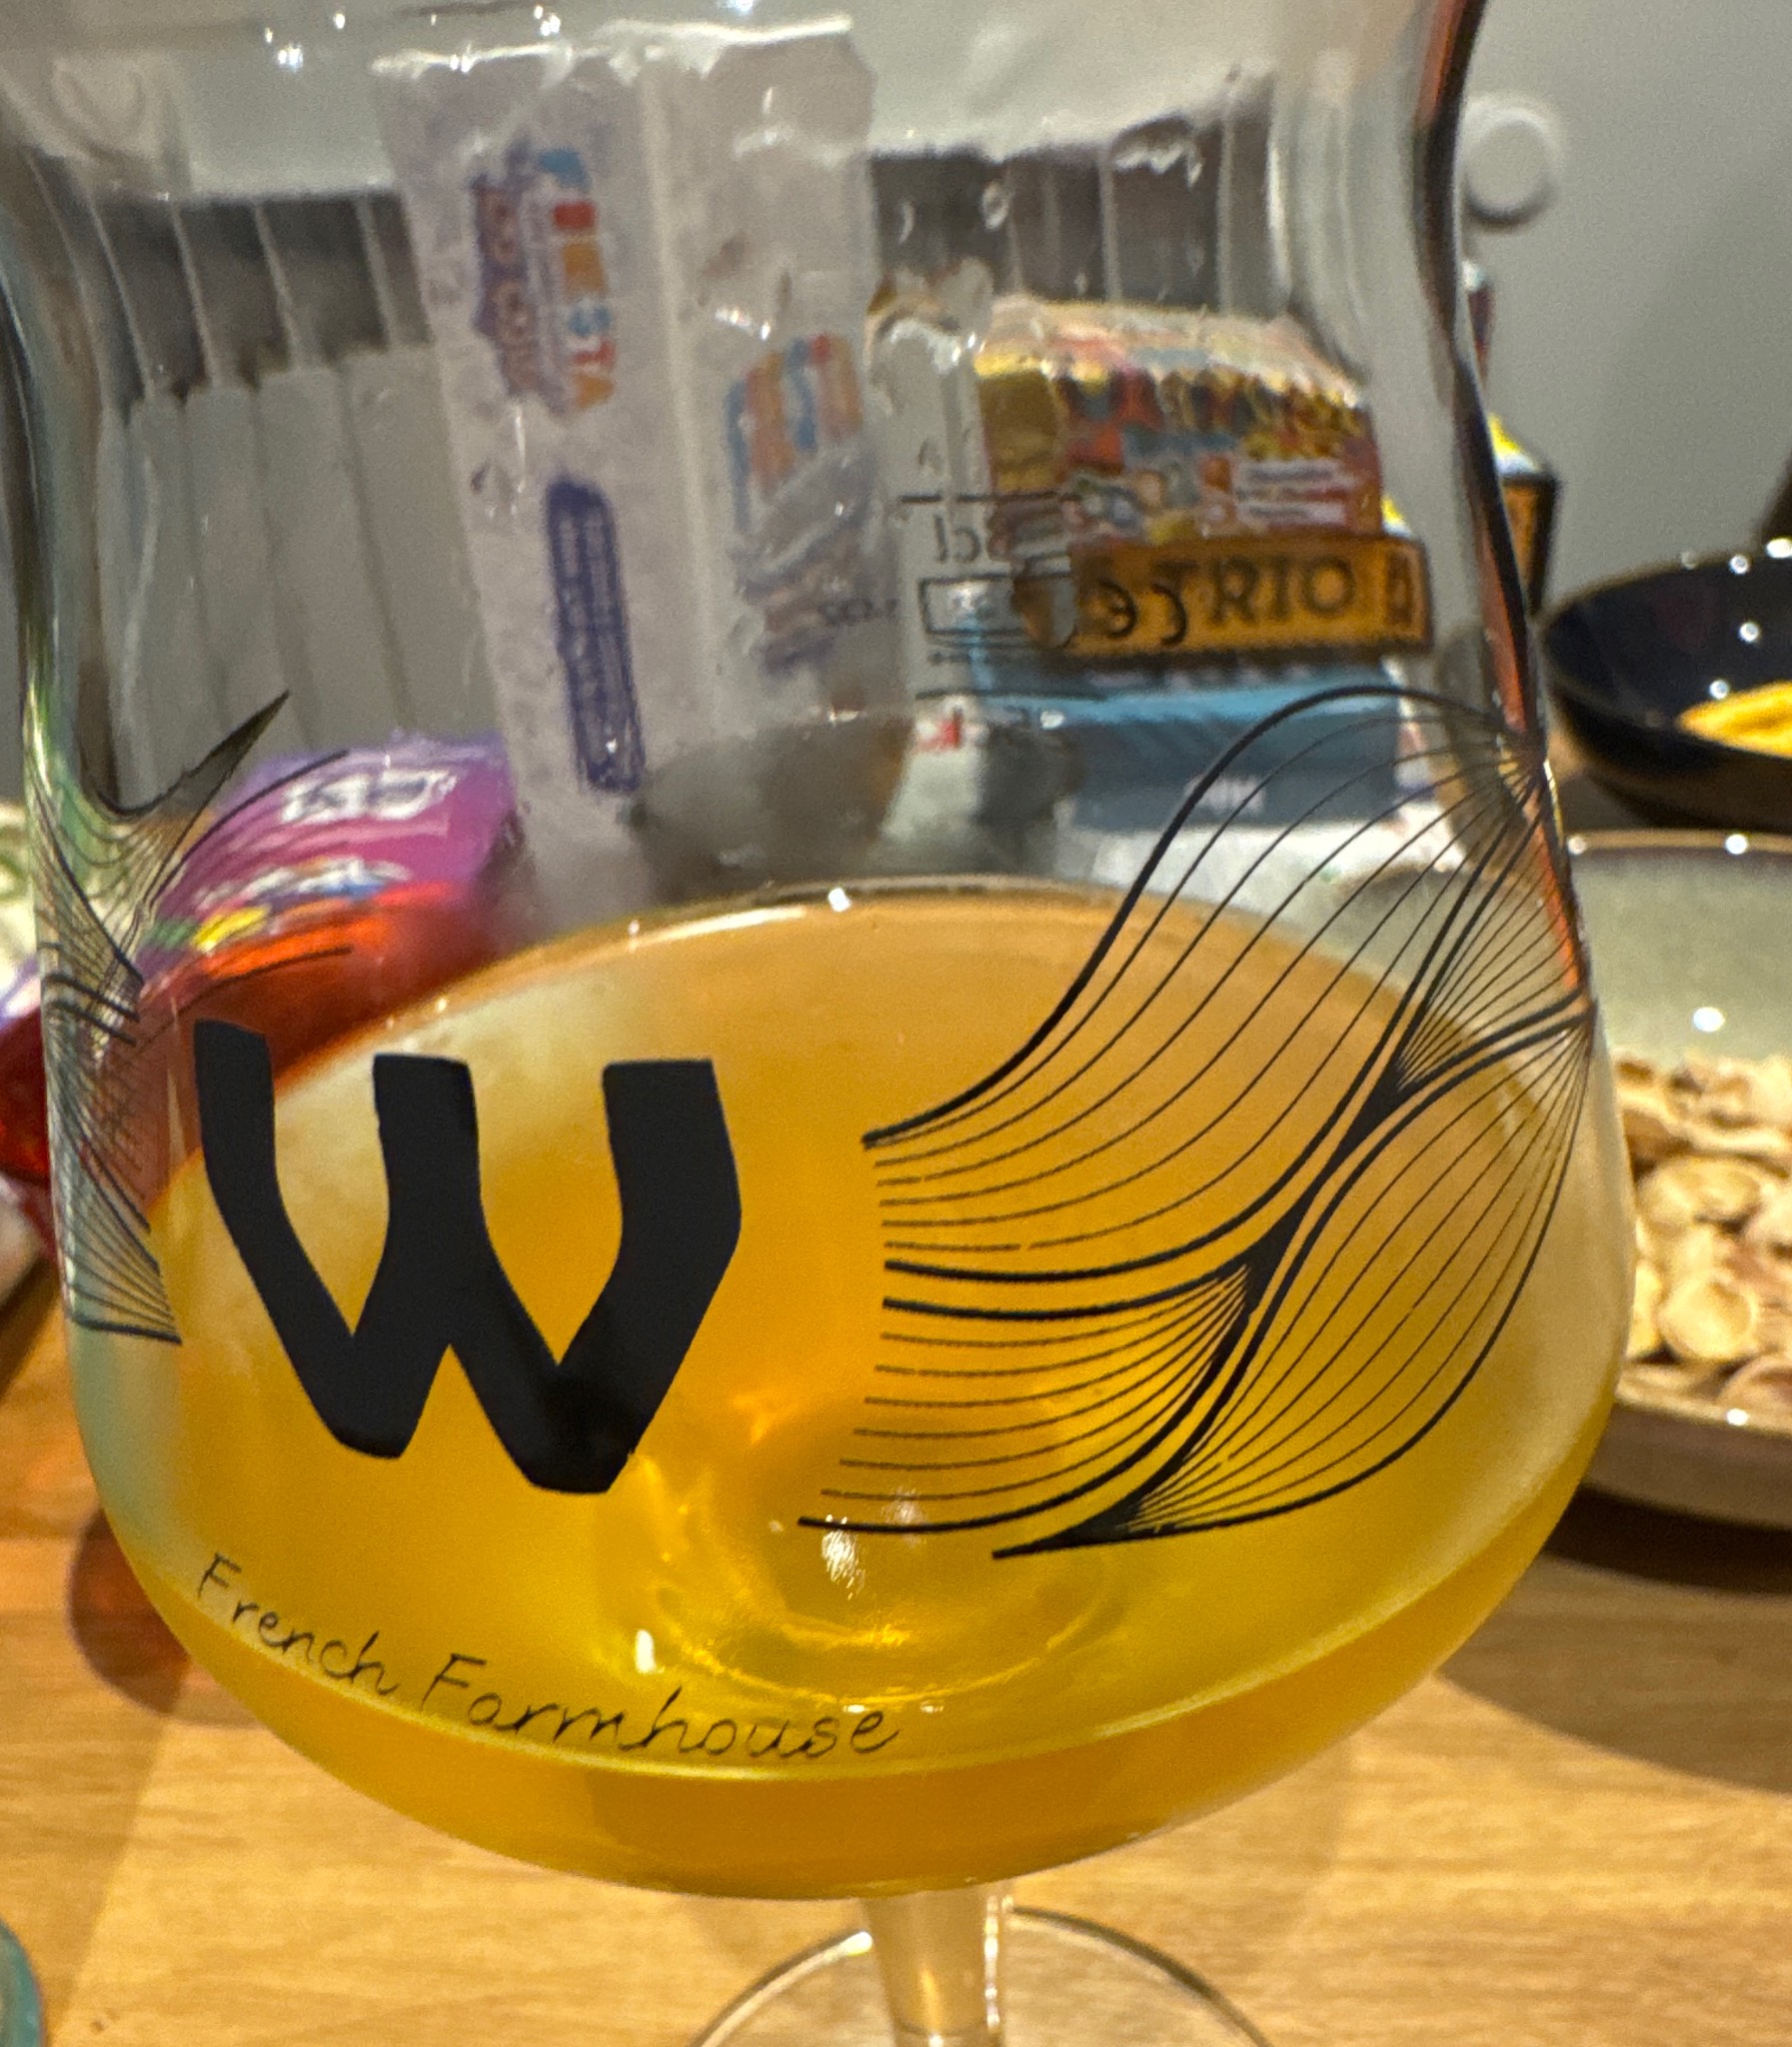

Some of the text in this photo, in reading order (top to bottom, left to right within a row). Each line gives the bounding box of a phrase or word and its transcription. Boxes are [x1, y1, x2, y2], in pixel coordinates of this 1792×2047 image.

[193, 1020, 742, 1494] W
[198, 1552, 901, 1759] French Farmhouse
